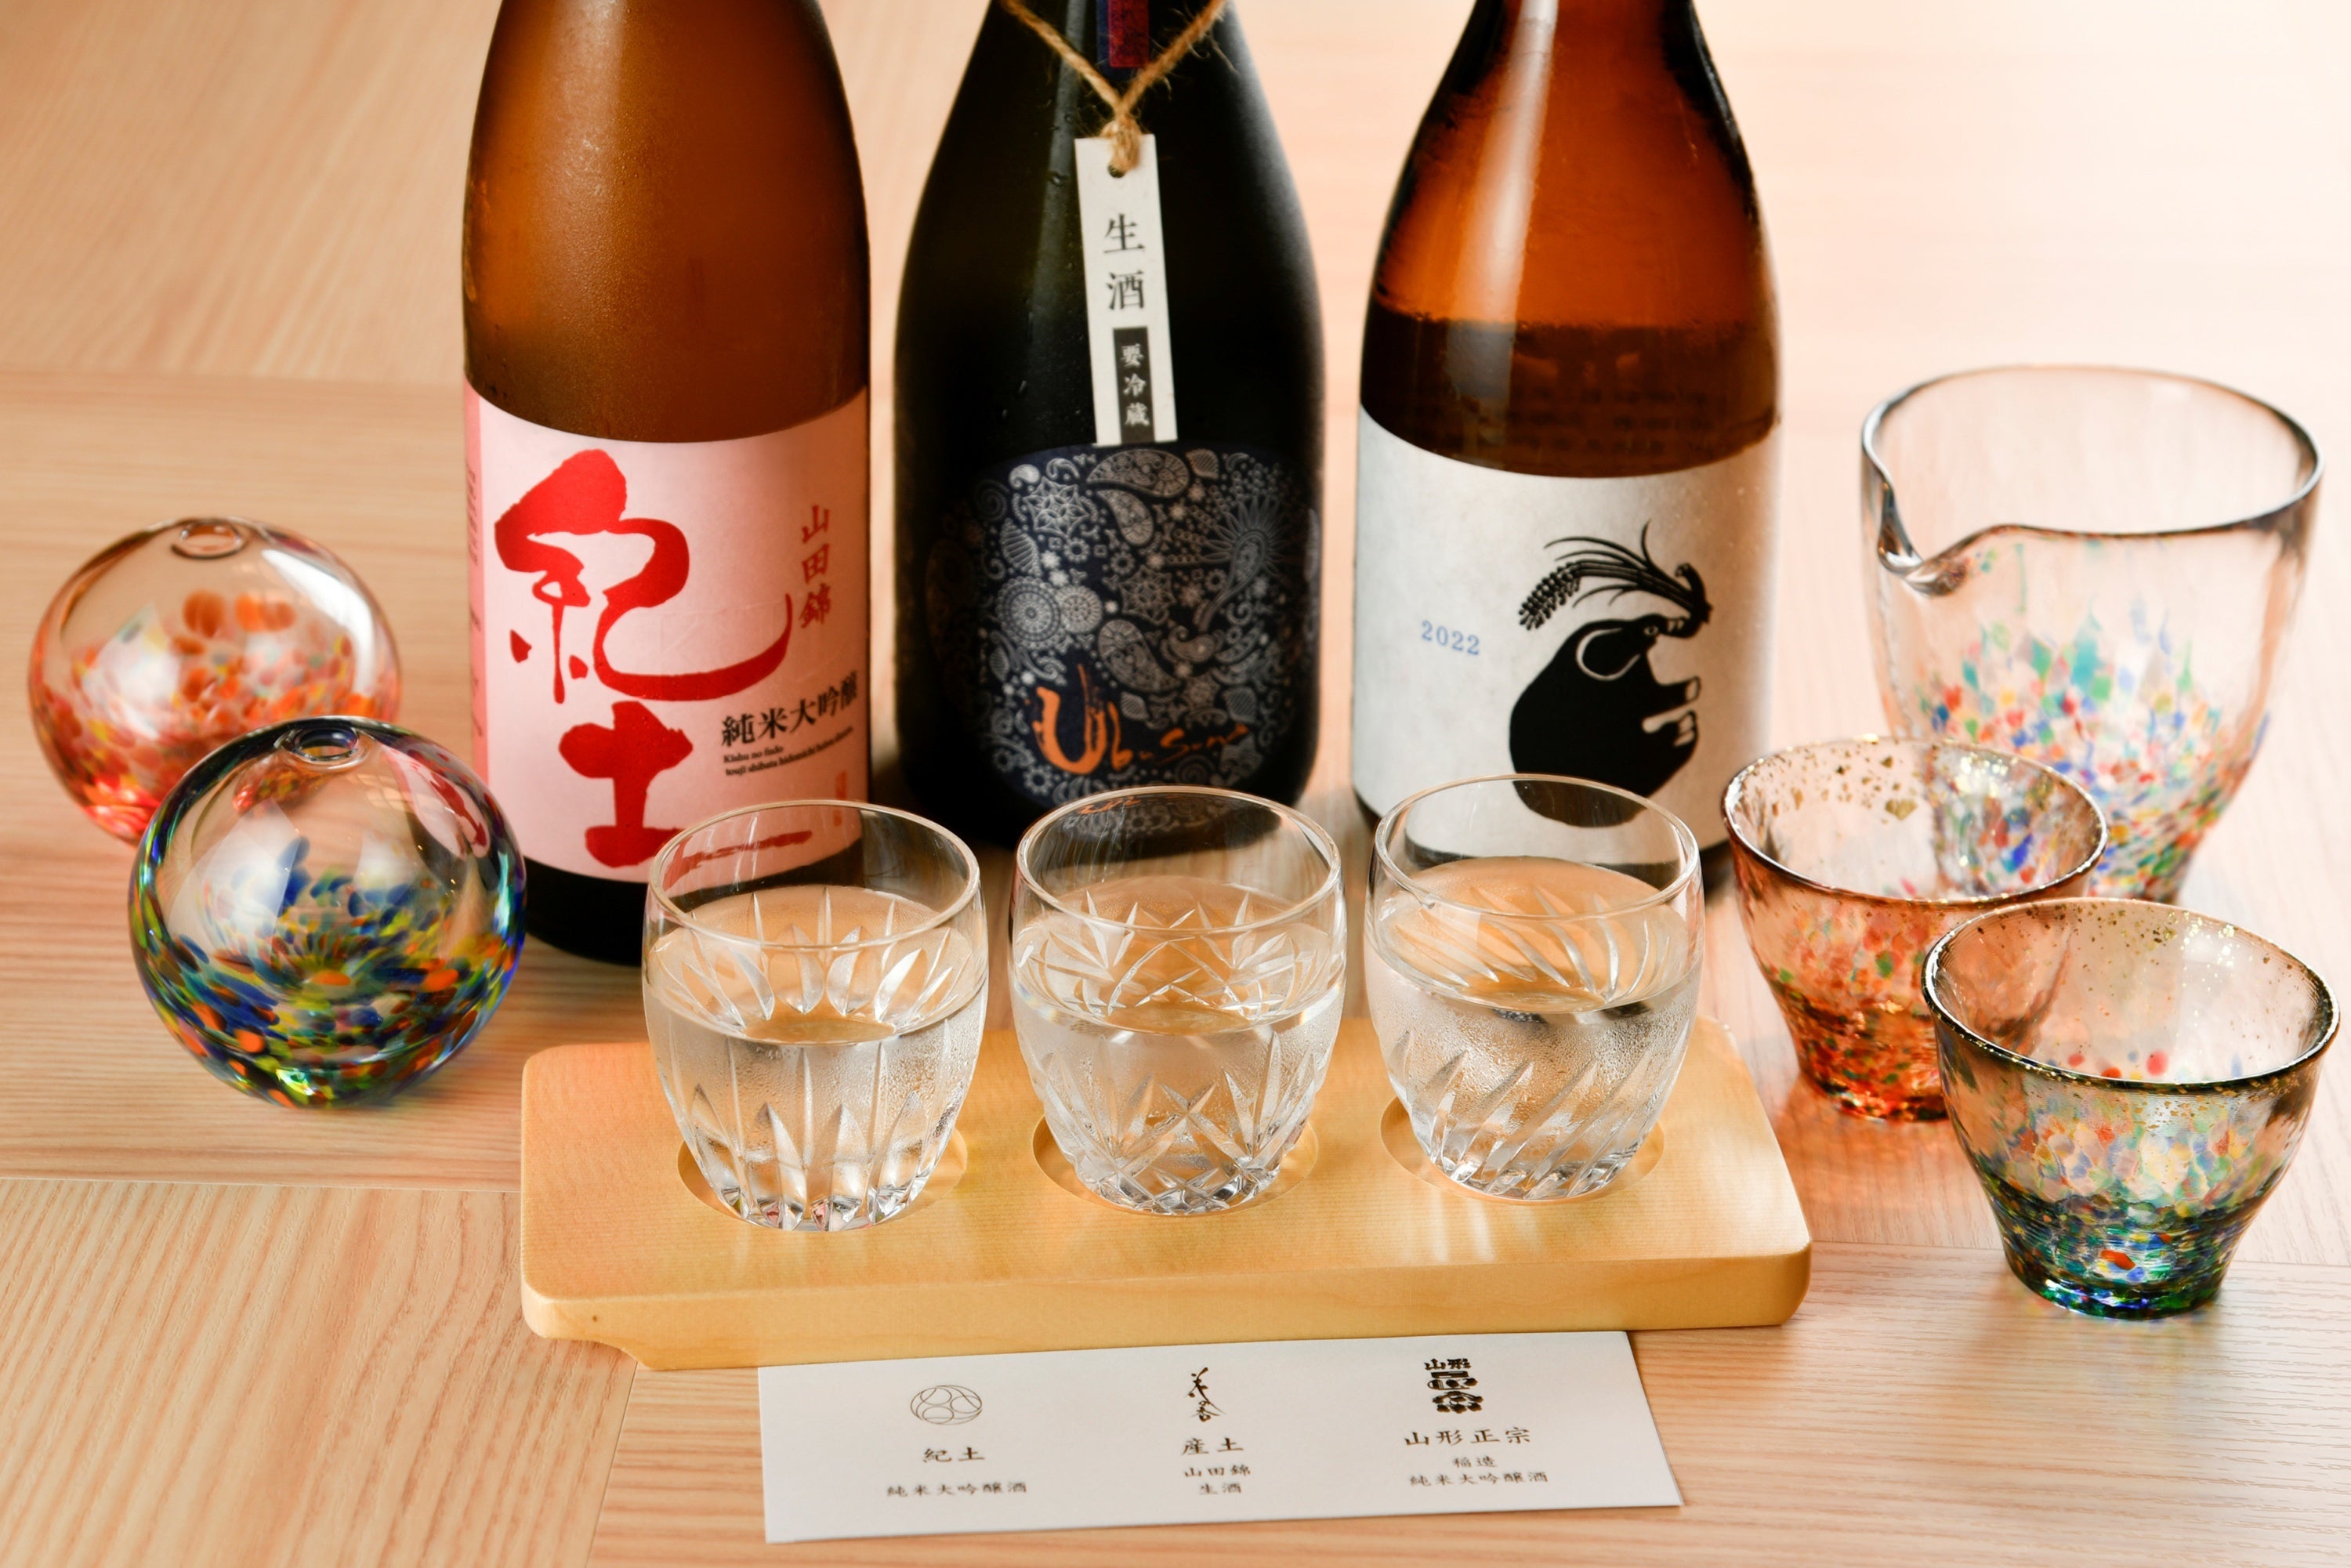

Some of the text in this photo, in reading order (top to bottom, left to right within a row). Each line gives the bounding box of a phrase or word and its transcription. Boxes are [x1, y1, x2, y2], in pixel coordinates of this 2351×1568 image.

[1103, 213, 1145, 310] 生酒
[1121, 343, 1150, 426] 要冷蔵
[799, 505, 831, 628] 山田錦
[1422, 620, 1480, 655] 2022
[494, 448, 813, 870] 紀土
[1182, 1437, 1244, 1456] 産土
[1404, 1427, 1531, 1447] 山形正宗
[922, 1447, 985, 1463] 紀土
[1184, 1465, 1251, 1478] 山田錦
[1409, 1472, 1549, 1487] 純米大吟醸酒
[887, 1482, 1027, 1497] 純米大吟醸酒
[1199, 1483, 1241, 1495] 生酒
